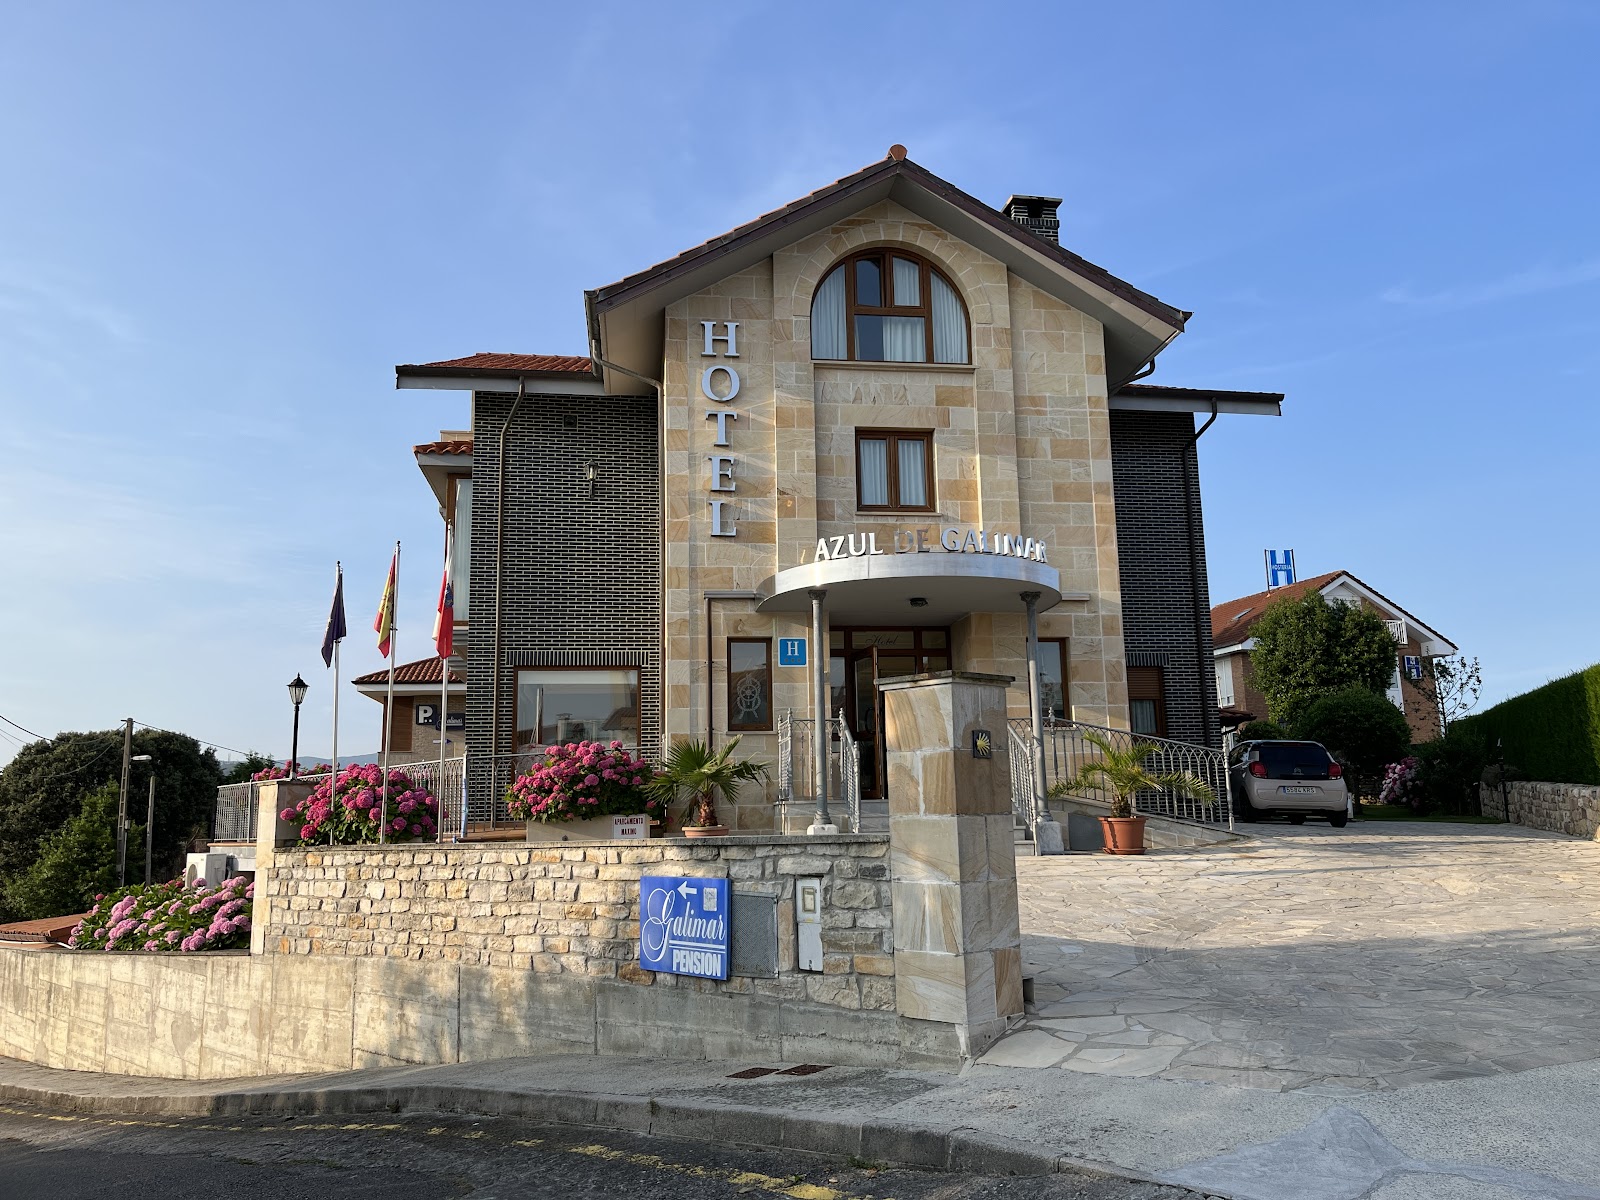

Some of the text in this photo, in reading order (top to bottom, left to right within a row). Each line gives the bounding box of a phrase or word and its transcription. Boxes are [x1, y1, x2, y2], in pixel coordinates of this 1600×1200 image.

[700, 321, 740, 536] HOTEL
[814, 527, 1048, 563] AZUL DE GALIMAR
[786, 640, 800, 656] H
[864, 634, 899, 645] Hotel
[641, 887, 726, 963] Galimar
[672, 949, 722, 977] PENSION
